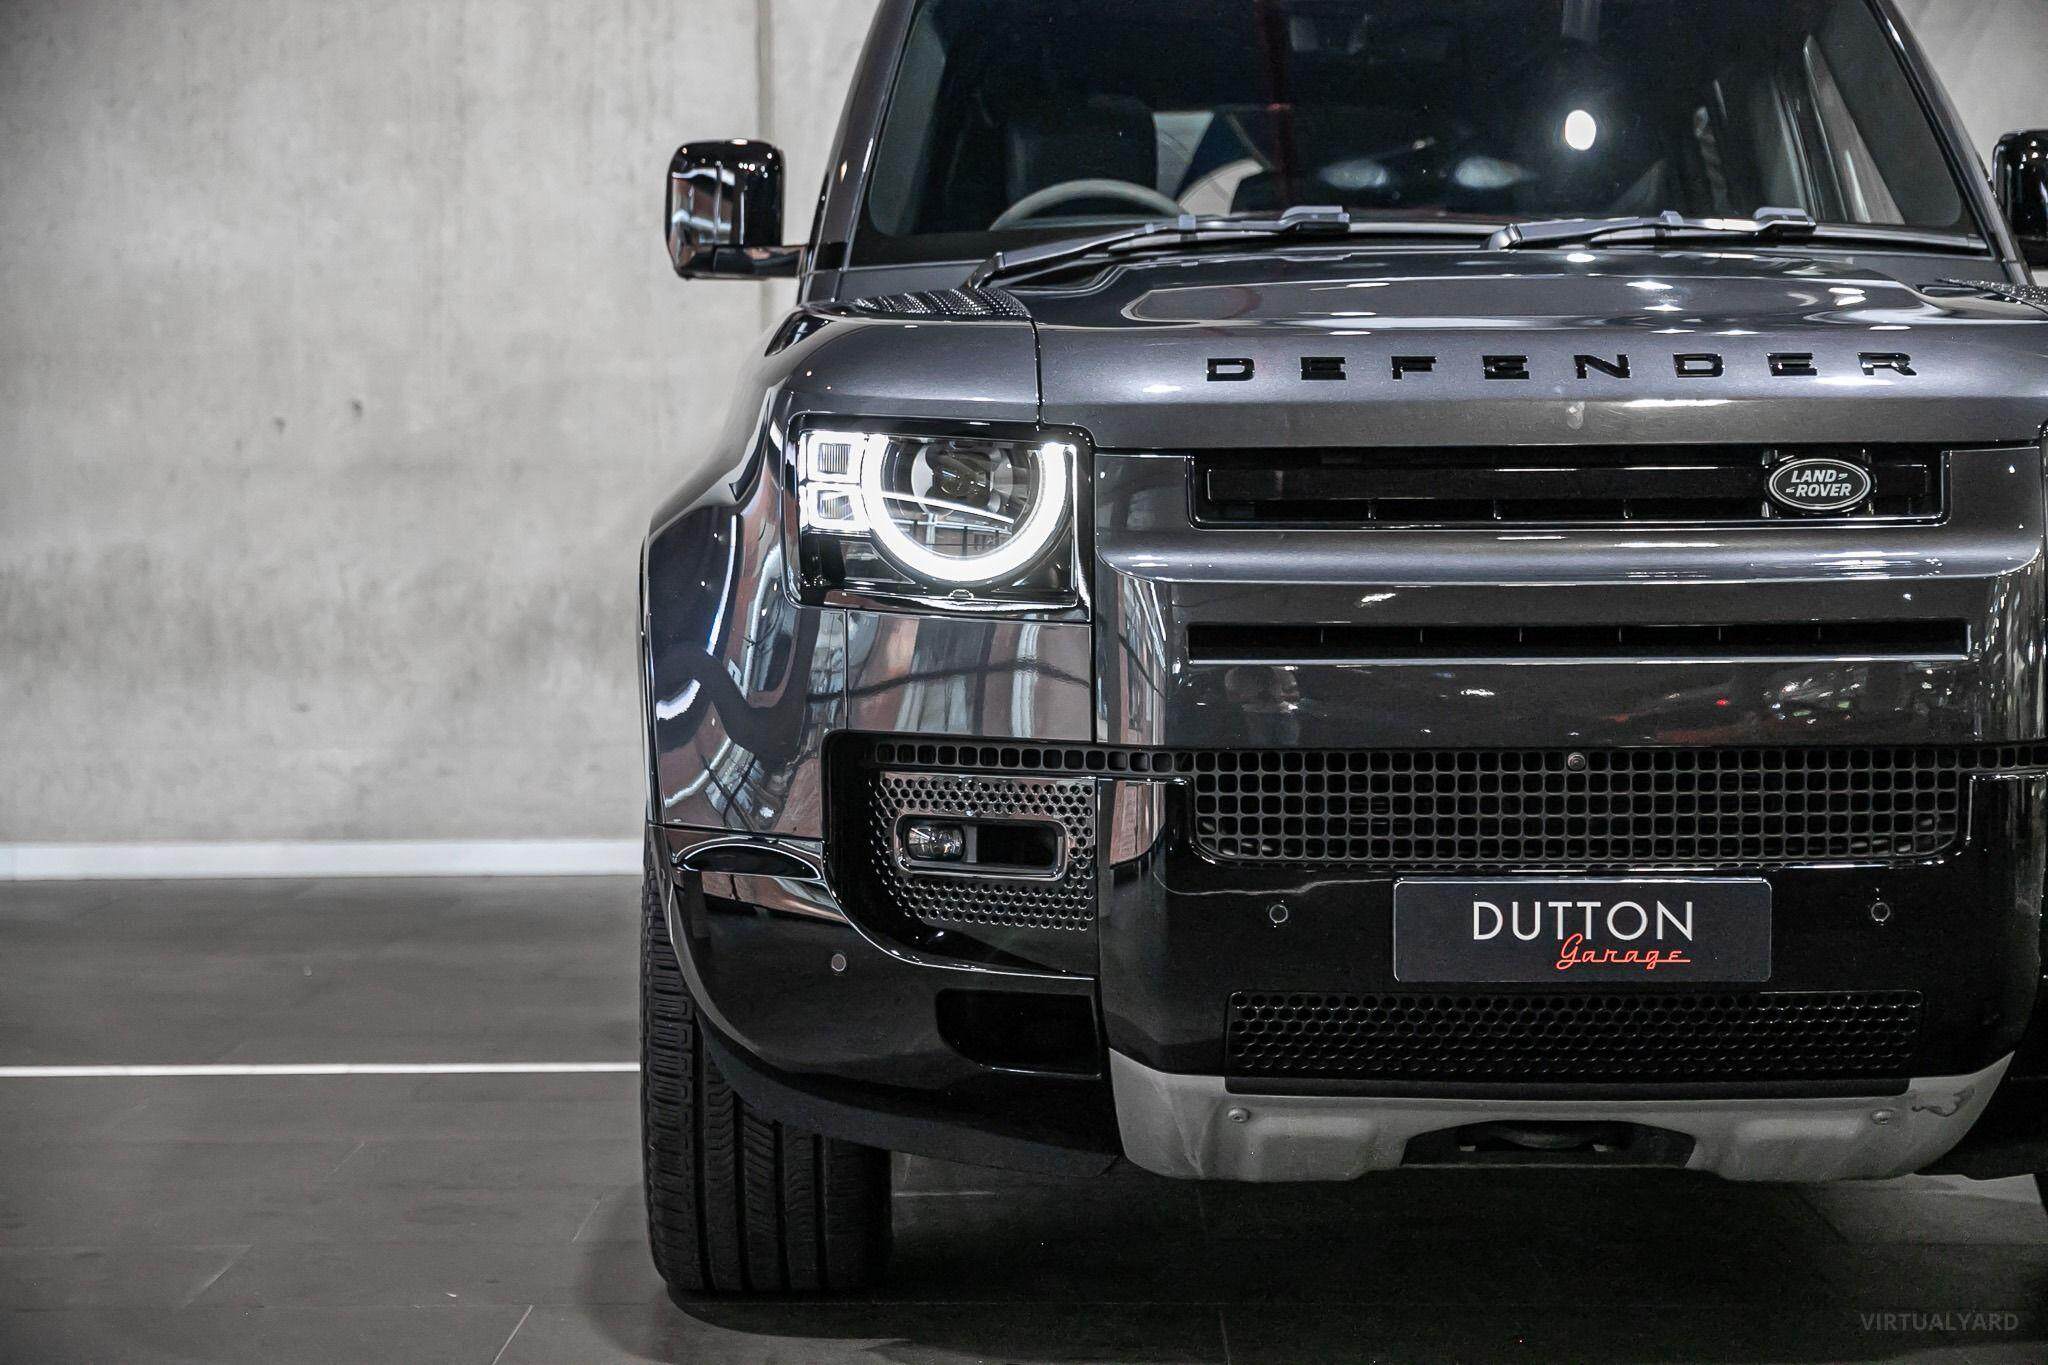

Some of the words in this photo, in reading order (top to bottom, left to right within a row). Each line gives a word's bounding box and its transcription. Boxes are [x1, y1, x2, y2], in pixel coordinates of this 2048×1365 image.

[1206, 352, 1918, 381] DEFENDER
[1790, 469, 1837, 483] LAND
[1795, 483, 1852, 498] ROVER
[1472, 900, 1694, 941] DUTTON
[1556, 932, 1691, 970] Garage
